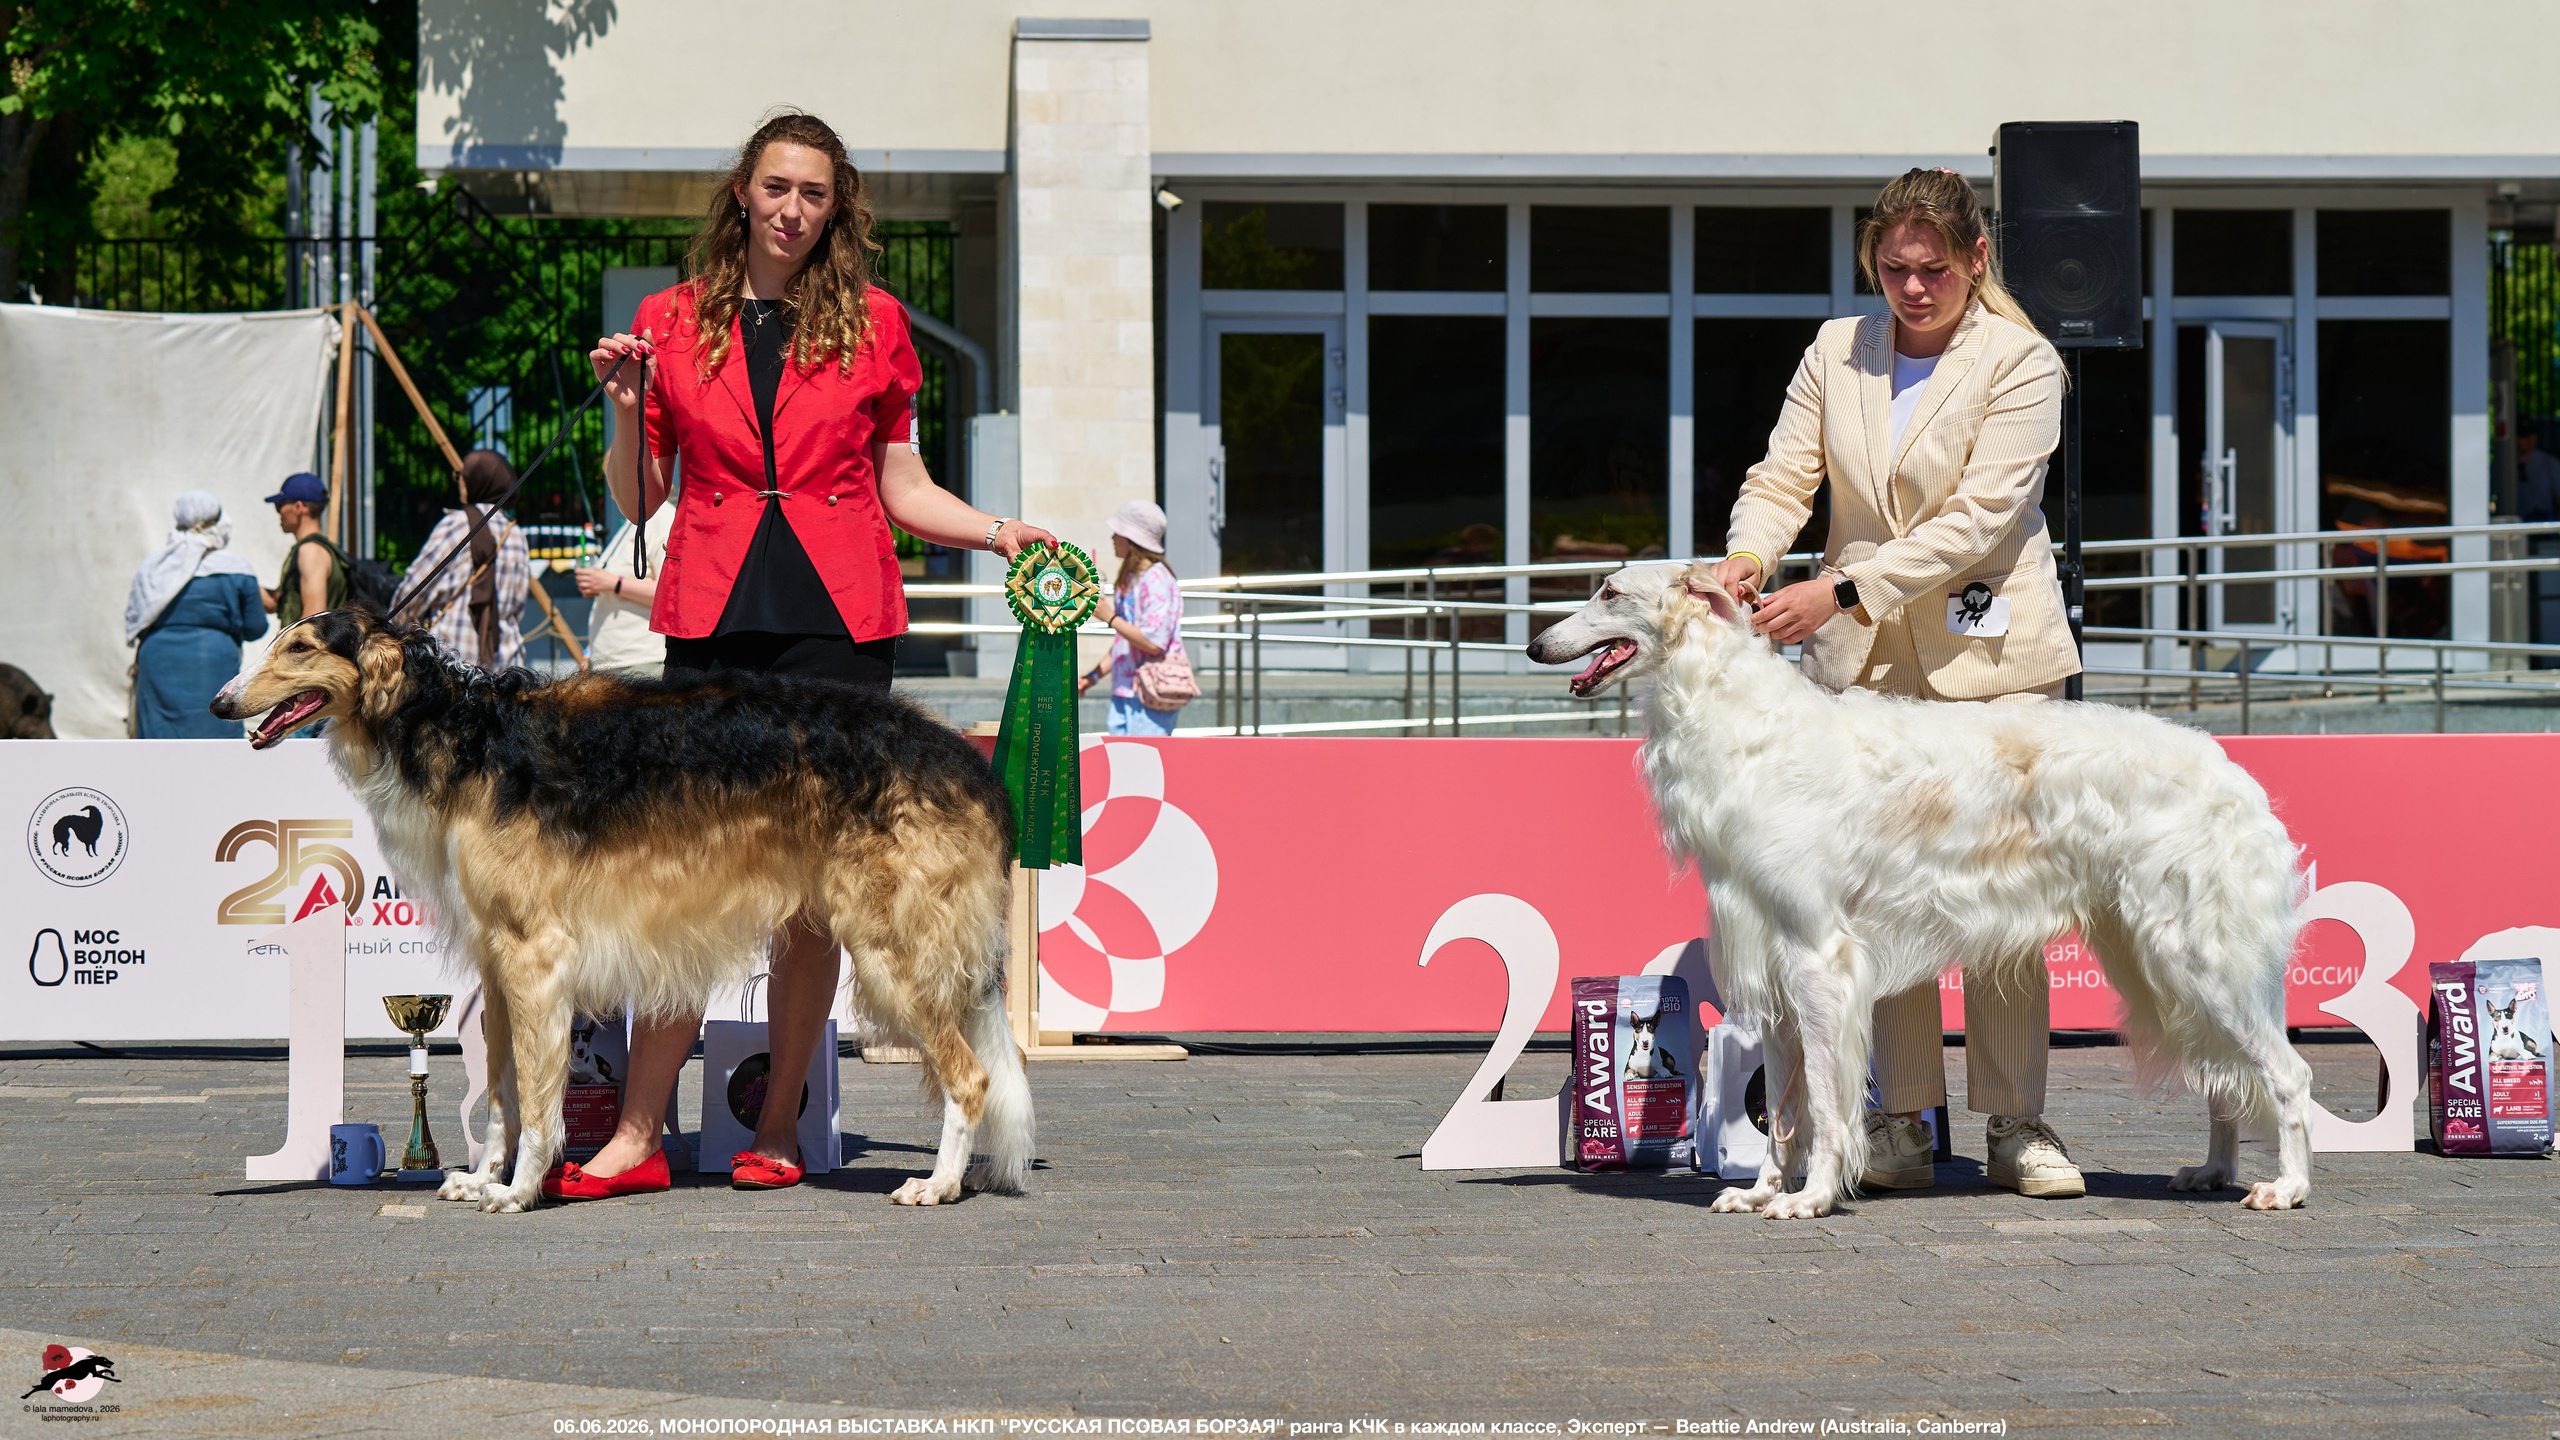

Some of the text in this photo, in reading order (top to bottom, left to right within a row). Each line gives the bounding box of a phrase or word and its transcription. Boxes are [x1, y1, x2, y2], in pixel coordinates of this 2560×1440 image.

[1029, 722, 1042, 812] ПРОМЕЖУТОЧНЫЙ
[1068, 776, 1076, 821] ВЫСТАВКА
[1026, 814, 1035, 845] КЛАСС
[40, 857, 115, 881] РУССКАЯ ПСОВАЯ БОРЗАЯ
[215, 819, 365, 925] 25
[74, 930, 120, 945] МОС
[74, 949, 145, 965] ВОЛОН
[1663, 1002, 1681, 1012] BIO
[2437, 982, 2477, 1095] Award
[1578, 1000, 1612, 1115] Award
[2447, 1107, 2482, 1118] CARE
[1584, 1119, 1617, 1127] SPECIAL
[1584, 1127, 1618, 1138] CARE
[1670, 1151, 1676, 1159] 2
